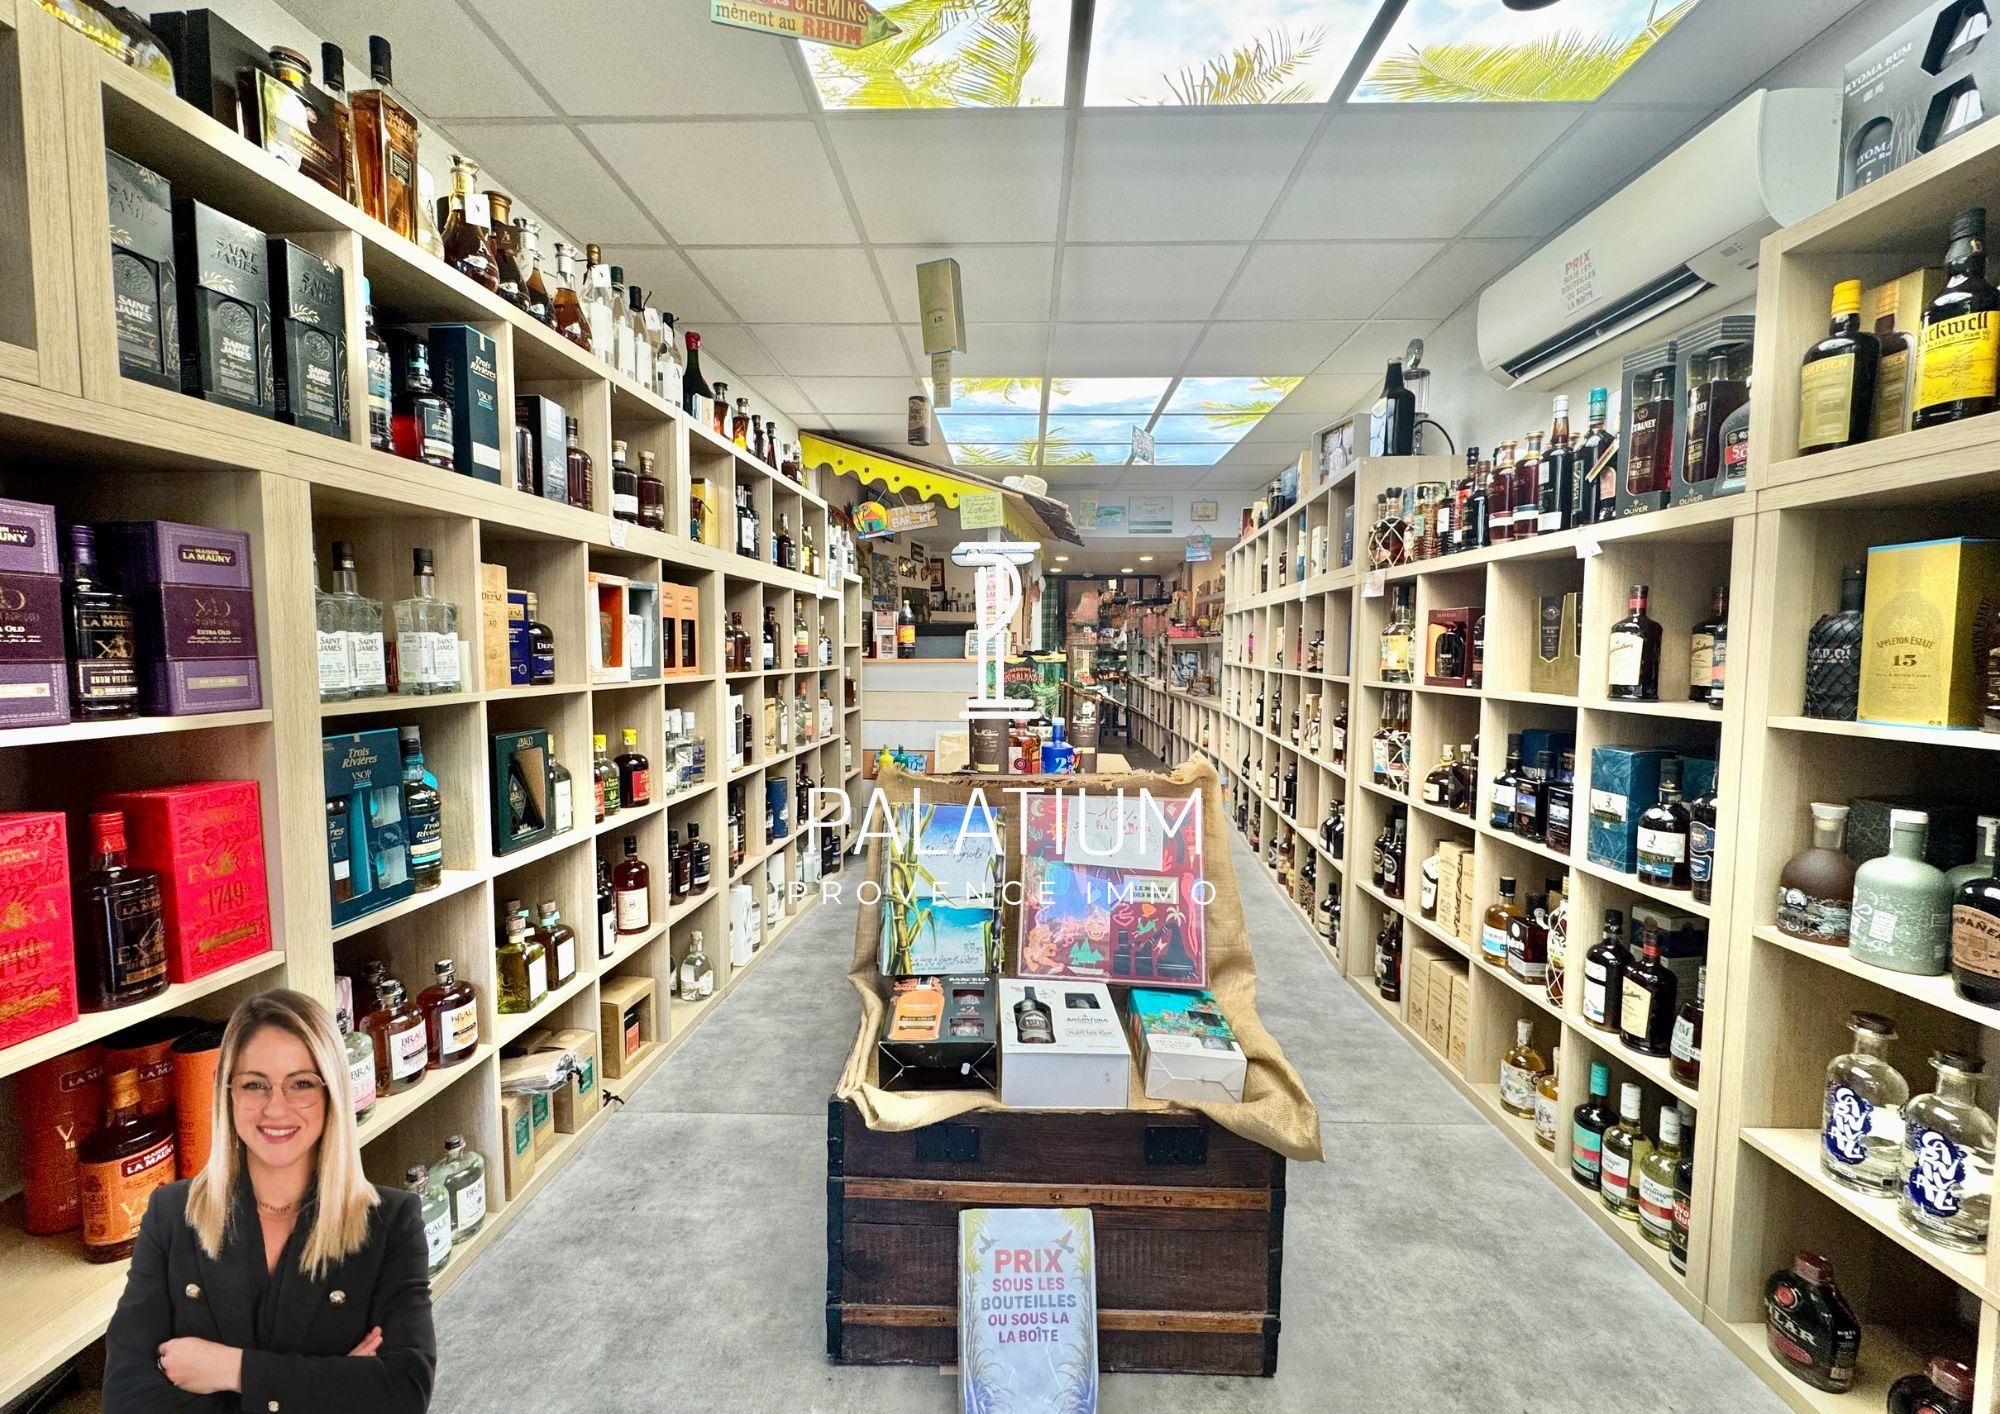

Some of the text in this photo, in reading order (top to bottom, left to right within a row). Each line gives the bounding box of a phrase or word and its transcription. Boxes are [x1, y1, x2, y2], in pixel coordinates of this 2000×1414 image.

[794, 0, 868, 22] CHEMINS
[716, 3, 863, 46] mènent au RHUM
[1845, 63, 1882, 94] RYOMA
[1885, 42, 1912, 66] RUM
[1565, 248, 1591, 275] PRIX
[118, 295, 152, 313] SAINT
[116, 306, 152, 323] JAMES
[222, 337, 251, 352] SAINT
[221, 347, 251, 361] JAMES
[475, 355, 491, 368] Trois
[308, 365, 331, 378] SAINT
[470, 361, 497, 379] Rivières
[307, 373, 332, 387] JAMES
[476, 389, 493, 402] VSOP
[1679, 495, 1703, 506] OLIVER
[1624, 505, 1648, 515] OLIVER
[182, 552, 231, 563] LA MAUNY
[4, 625, 25, 633] OLD
[81, 619, 100, 628] LA
[320, 637, 342, 645] SAINT
[1876, 636, 1936, 649] APPLETON ESTATE
[1892, 655, 1918, 667] 15
[348, 748, 369, 757] Trois
[342, 754, 377, 768] Rivières
[352, 770, 371, 781] VSOP
[207, 881, 246, 916] 1749
[143, 1145, 169, 1160] MAISON
[127, 1161, 144, 1174] LA
[995, 1249, 1064, 1274] PRIX
[992, 1277, 1065, 1292] SOUS LES
[981, 1294, 1077, 1311] BOUTEILLES
[988, 1311, 1069, 1326] OU SOUS LA
[998, 1327, 1059, 1344] LA BOÎTE
